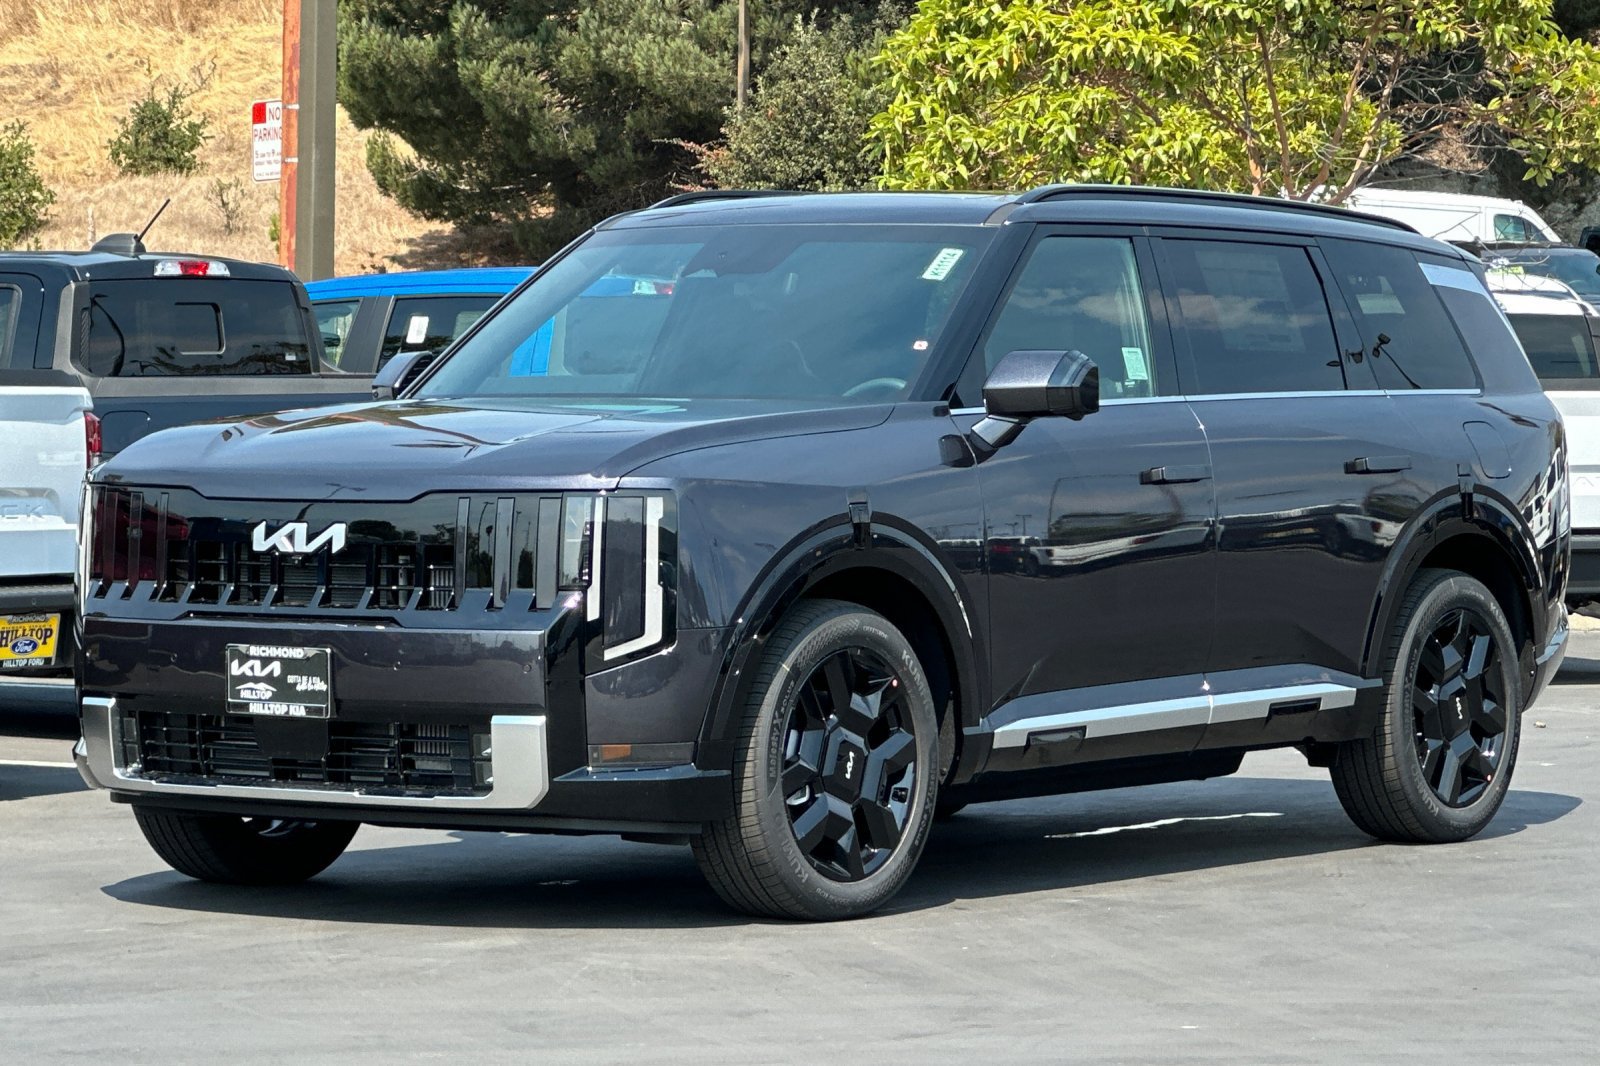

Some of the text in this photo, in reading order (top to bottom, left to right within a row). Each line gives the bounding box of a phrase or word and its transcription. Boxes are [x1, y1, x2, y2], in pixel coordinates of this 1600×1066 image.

[268, 107, 281, 120] NO
[252, 520, 346, 554] KIA
[0, 627, 53, 648] HILLTOP
[14, 640, 35, 653] Ford
[249, 645, 305, 658] RICHMOND
[2, 658, 45, 668] HILLTOP FORD
[230, 658, 281, 677] KIA
[240, 689, 273, 700] HILLTOP
[249, 702, 307, 716] HILLTOP KIA
